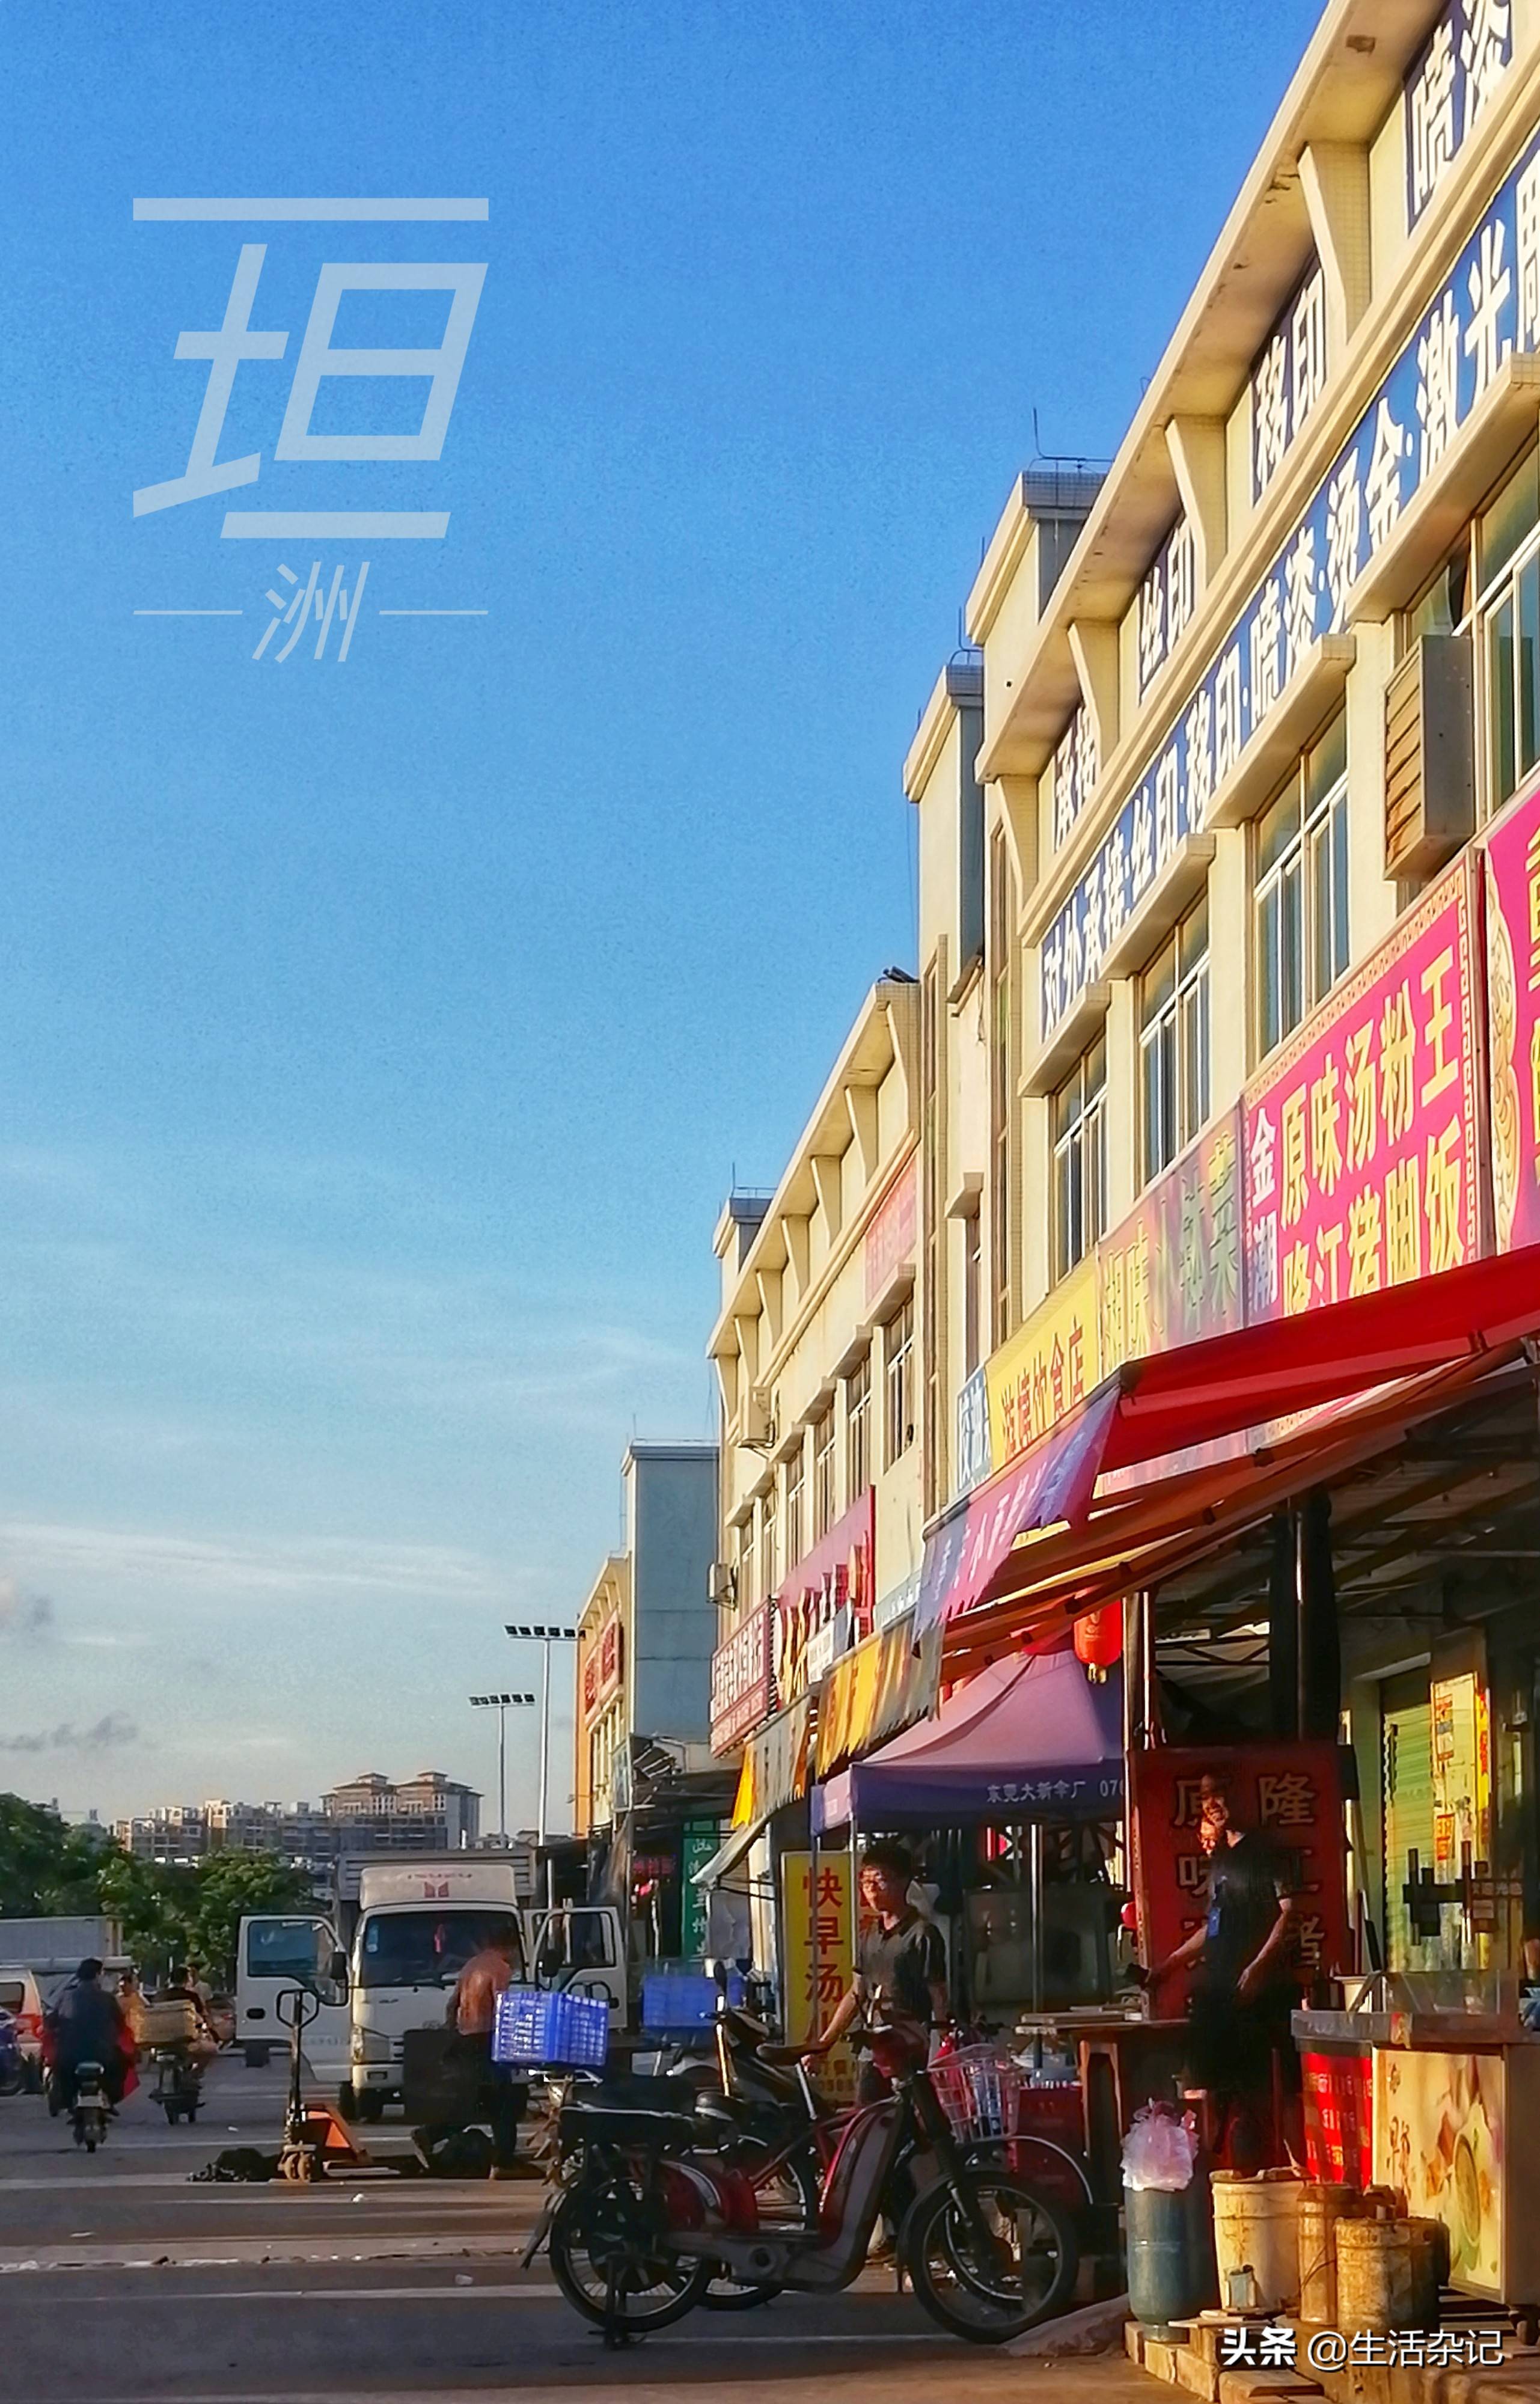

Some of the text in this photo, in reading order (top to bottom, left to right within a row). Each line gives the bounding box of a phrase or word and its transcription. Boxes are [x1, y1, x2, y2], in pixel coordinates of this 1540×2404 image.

[1280, 946, 1459, 1230] 原味汤粉王
[1283, 1115, 1464, 1317] 隆江猪脚饭
[987, 1779, 1086, 1803] 东莞大新伞厂
